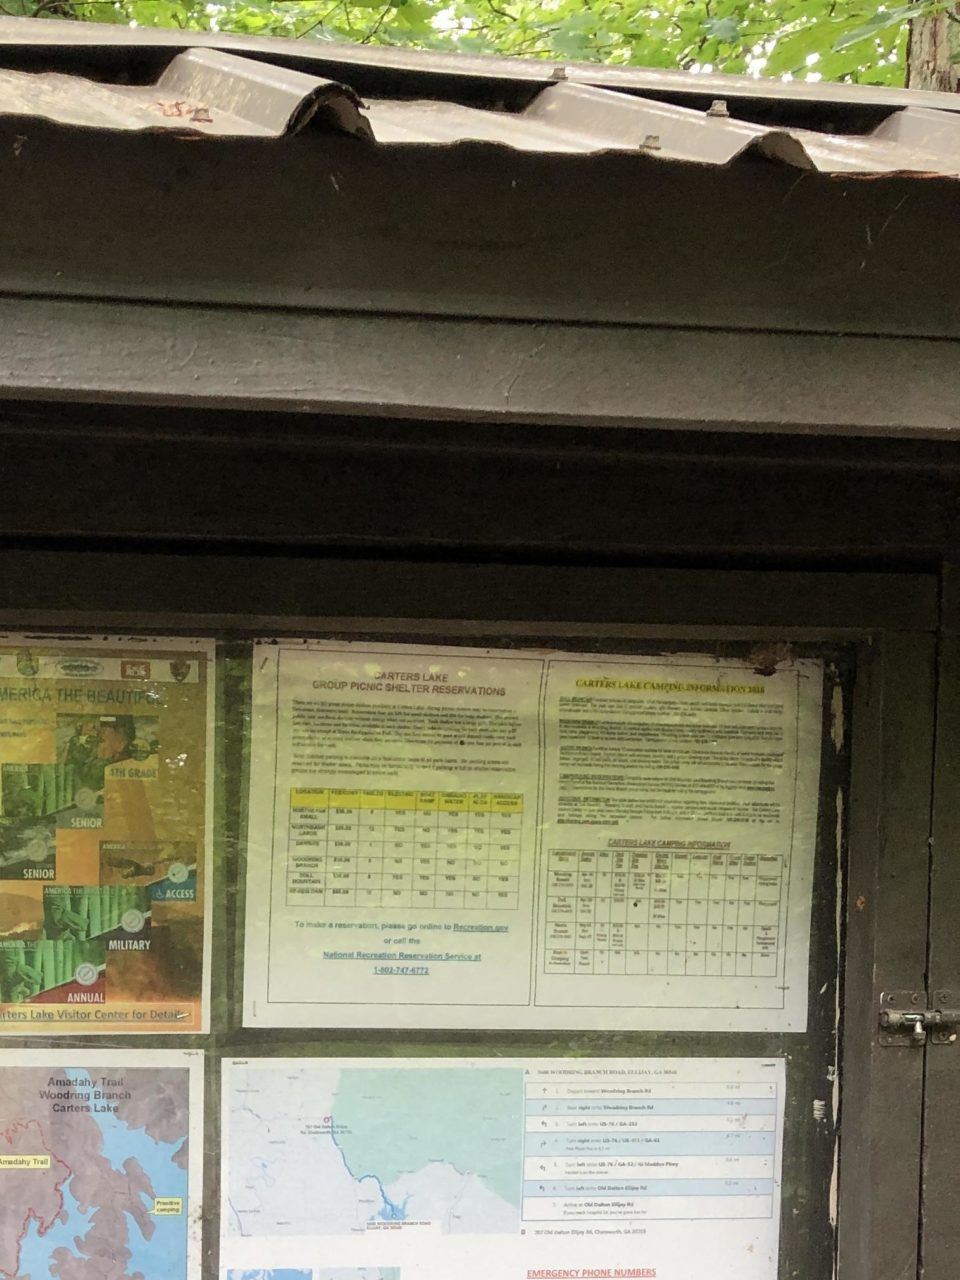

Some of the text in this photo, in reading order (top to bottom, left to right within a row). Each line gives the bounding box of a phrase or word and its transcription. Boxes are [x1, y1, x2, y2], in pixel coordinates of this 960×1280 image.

[375, 671, 449, 683] CARTERS LAKE
[313, 680, 506, 696] GROUP PICNIC SHELTER RESERVATIONS
[56, 690, 82, 703] THE
[88, 691, 162, 705] BEAUTIFUL
[129, 768, 158, 779] GRADE
[71, 817, 103, 829] SENIOR
[608, 839, 731, 849] CARTERS LAKE CAMPING INFORMATION
[23, 869, 55, 879] SENIOR
[166, 889, 194, 899] ACCESS
[108, 940, 151, 951] MILITARY
[323, 951, 481, 961] National Recreation Reservation Service at
[67, 992, 105, 1003] ANNUAL
[31, 1009, 54, 1020] Lake
[57, 1009, 91, 1021] Visitor
[95, 1009, 129, 1021] Center
[133, 1009, 147, 1021] for
[48, 1077, 124, 1088] Amadahy Trail
[40, 1090, 132, 1101] Woodring Branch
[53, 1103, 119, 1113] Carters Lake
[33, 1158, 48, 1166] Trail
[527, 1268, 656, 1278] EMERGENCY PHONE NUMBERS
